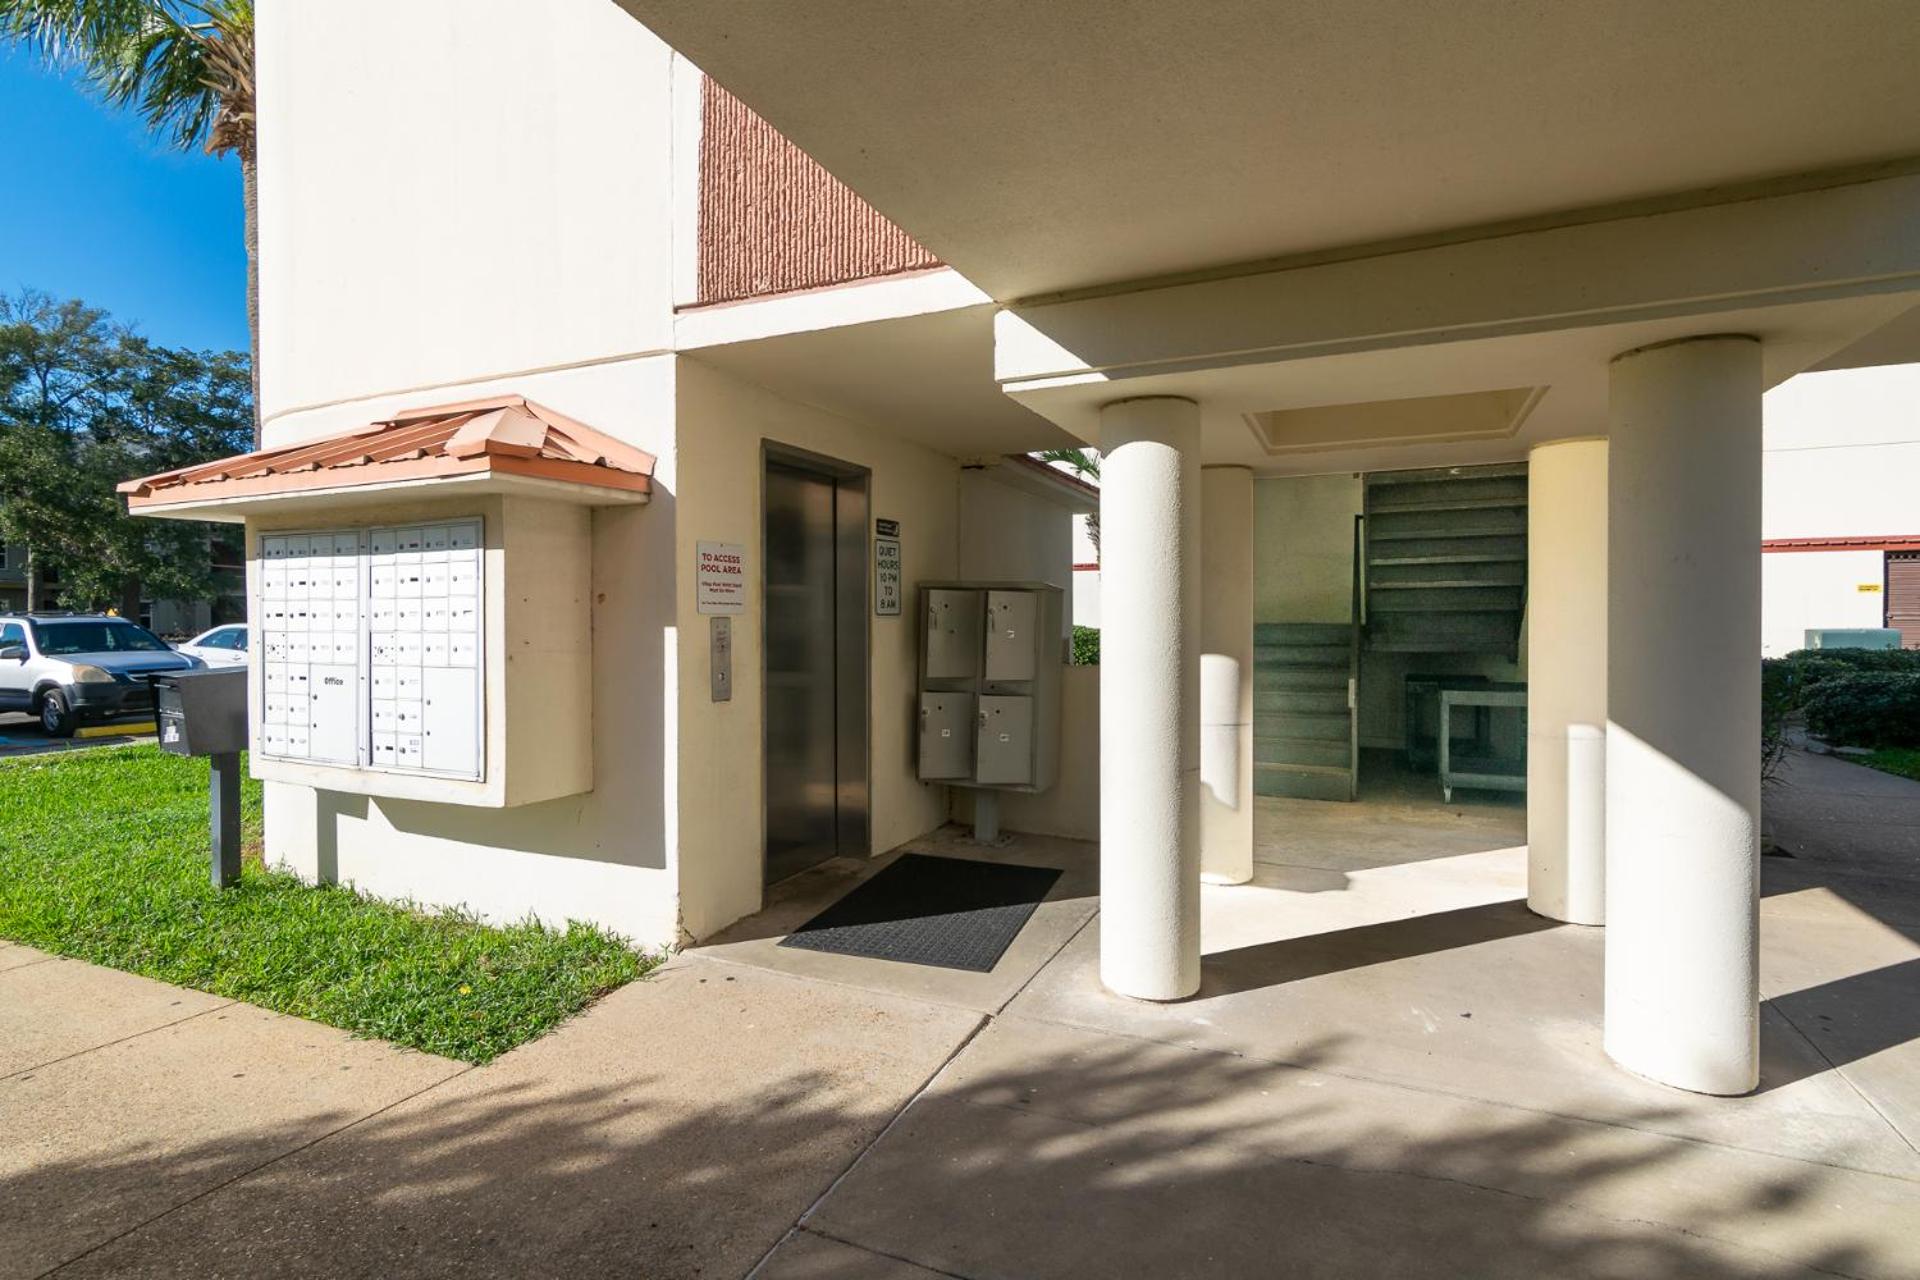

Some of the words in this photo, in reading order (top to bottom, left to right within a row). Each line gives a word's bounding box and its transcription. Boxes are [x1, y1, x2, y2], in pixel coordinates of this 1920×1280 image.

[702, 553, 713, 561] TO
[714, 554, 740, 564] ACCESS
[701, 564, 721, 573] POOL
[723, 566, 742, 574] AREA
[884, 586, 893, 596] TO
[324, 676, 344, 686] Office
